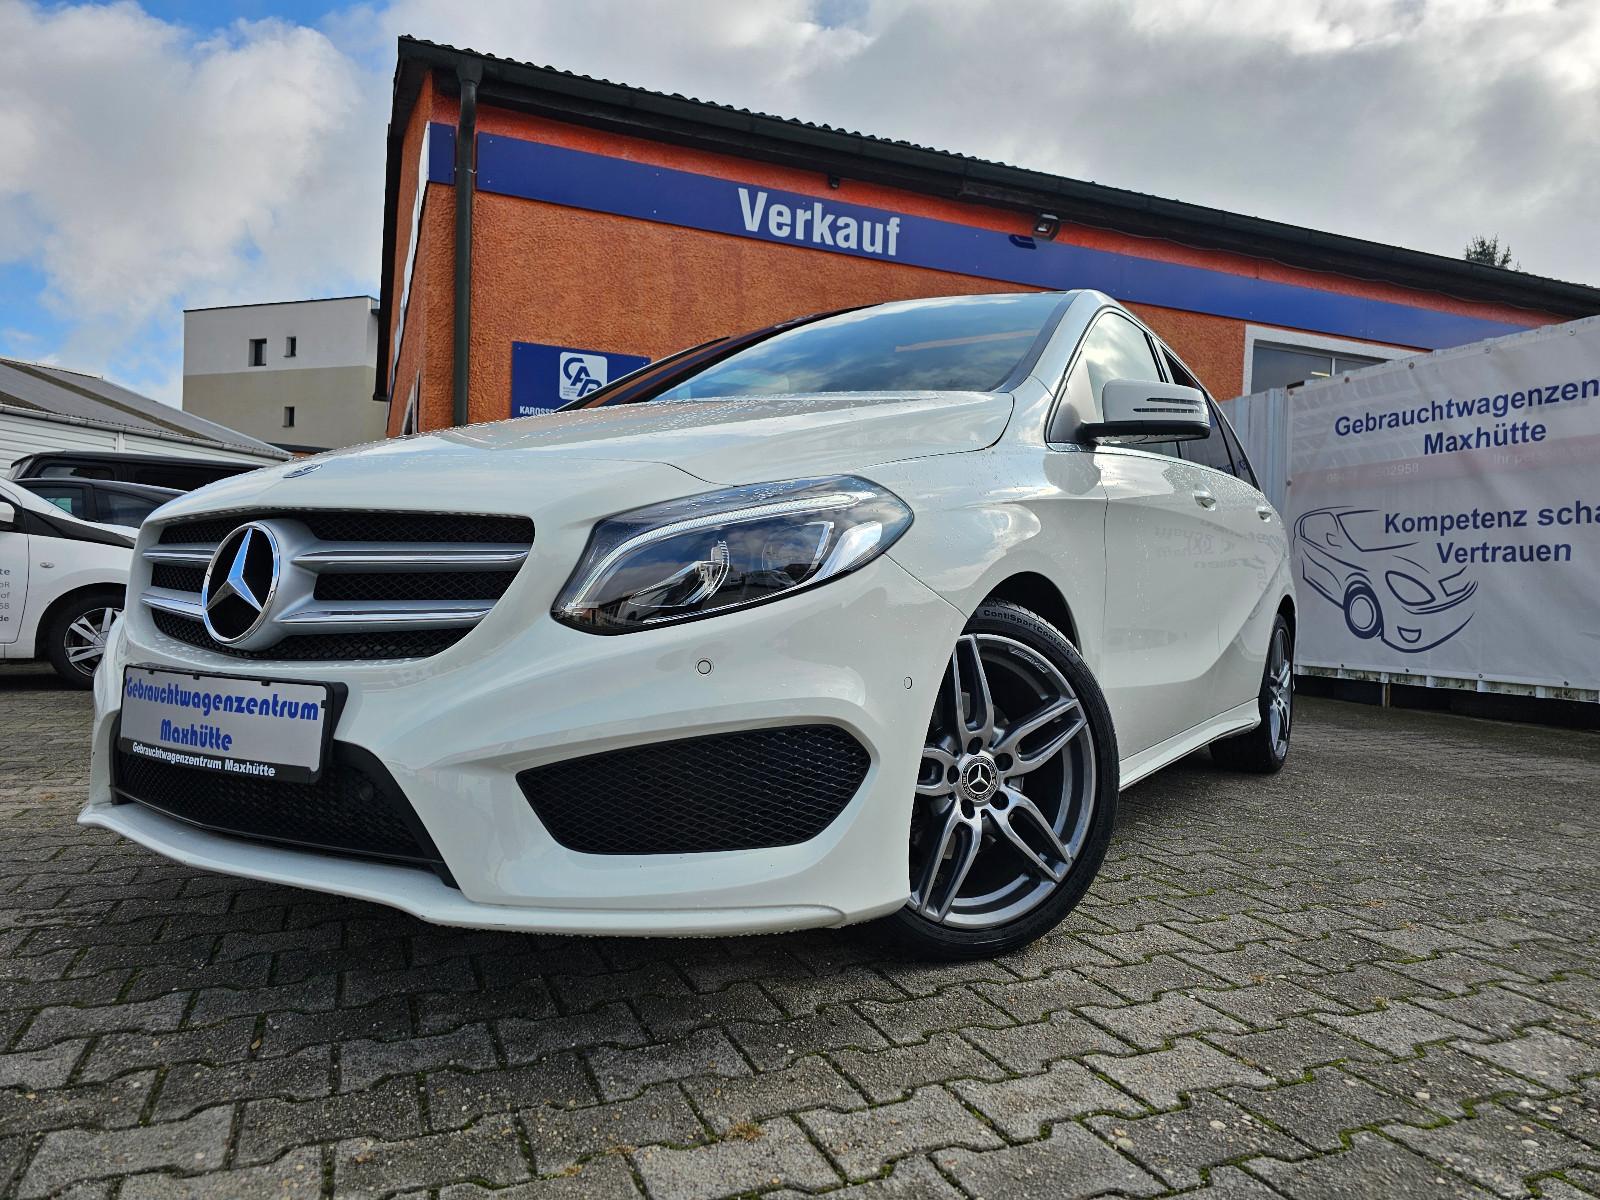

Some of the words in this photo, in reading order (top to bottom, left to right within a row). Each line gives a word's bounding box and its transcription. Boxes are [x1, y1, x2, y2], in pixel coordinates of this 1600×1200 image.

[738, 187, 900, 256] Verkauf
[1334, 379, 1600, 436] Gebrauchtwagenzen
[1424, 421, 1547, 455] Maxhütte
[1384, 509, 1528, 536] Kompetenz
[1436, 542, 1572, 564] Vertrauen
[126, 676, 319, 720] Gebrauchtwagenzentrum
[160, 718, 233, 751] Maxhütte
[132, 741, 222, 770] Gebrauchtwagenzentrum
[224, 758, 276, 777] Maxhütte
